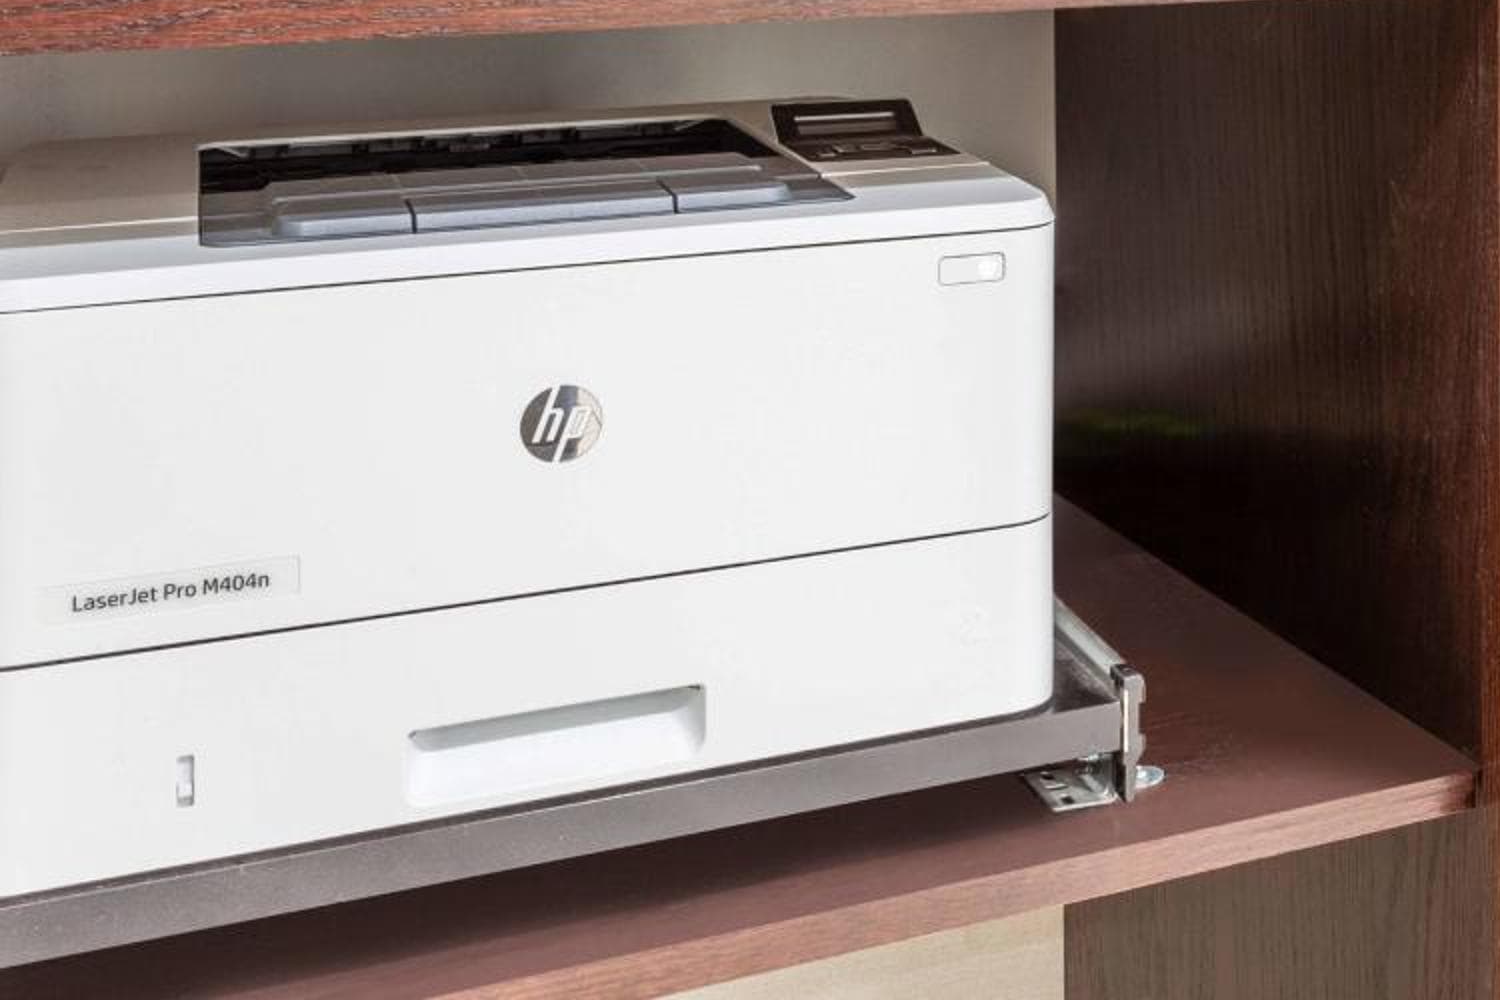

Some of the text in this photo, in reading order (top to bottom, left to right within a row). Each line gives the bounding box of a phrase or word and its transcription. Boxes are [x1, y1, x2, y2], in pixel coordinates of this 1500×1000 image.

[529, 384, 594, 463] hp
[71, 573, 270, 613] LaserJet Pro M404n
